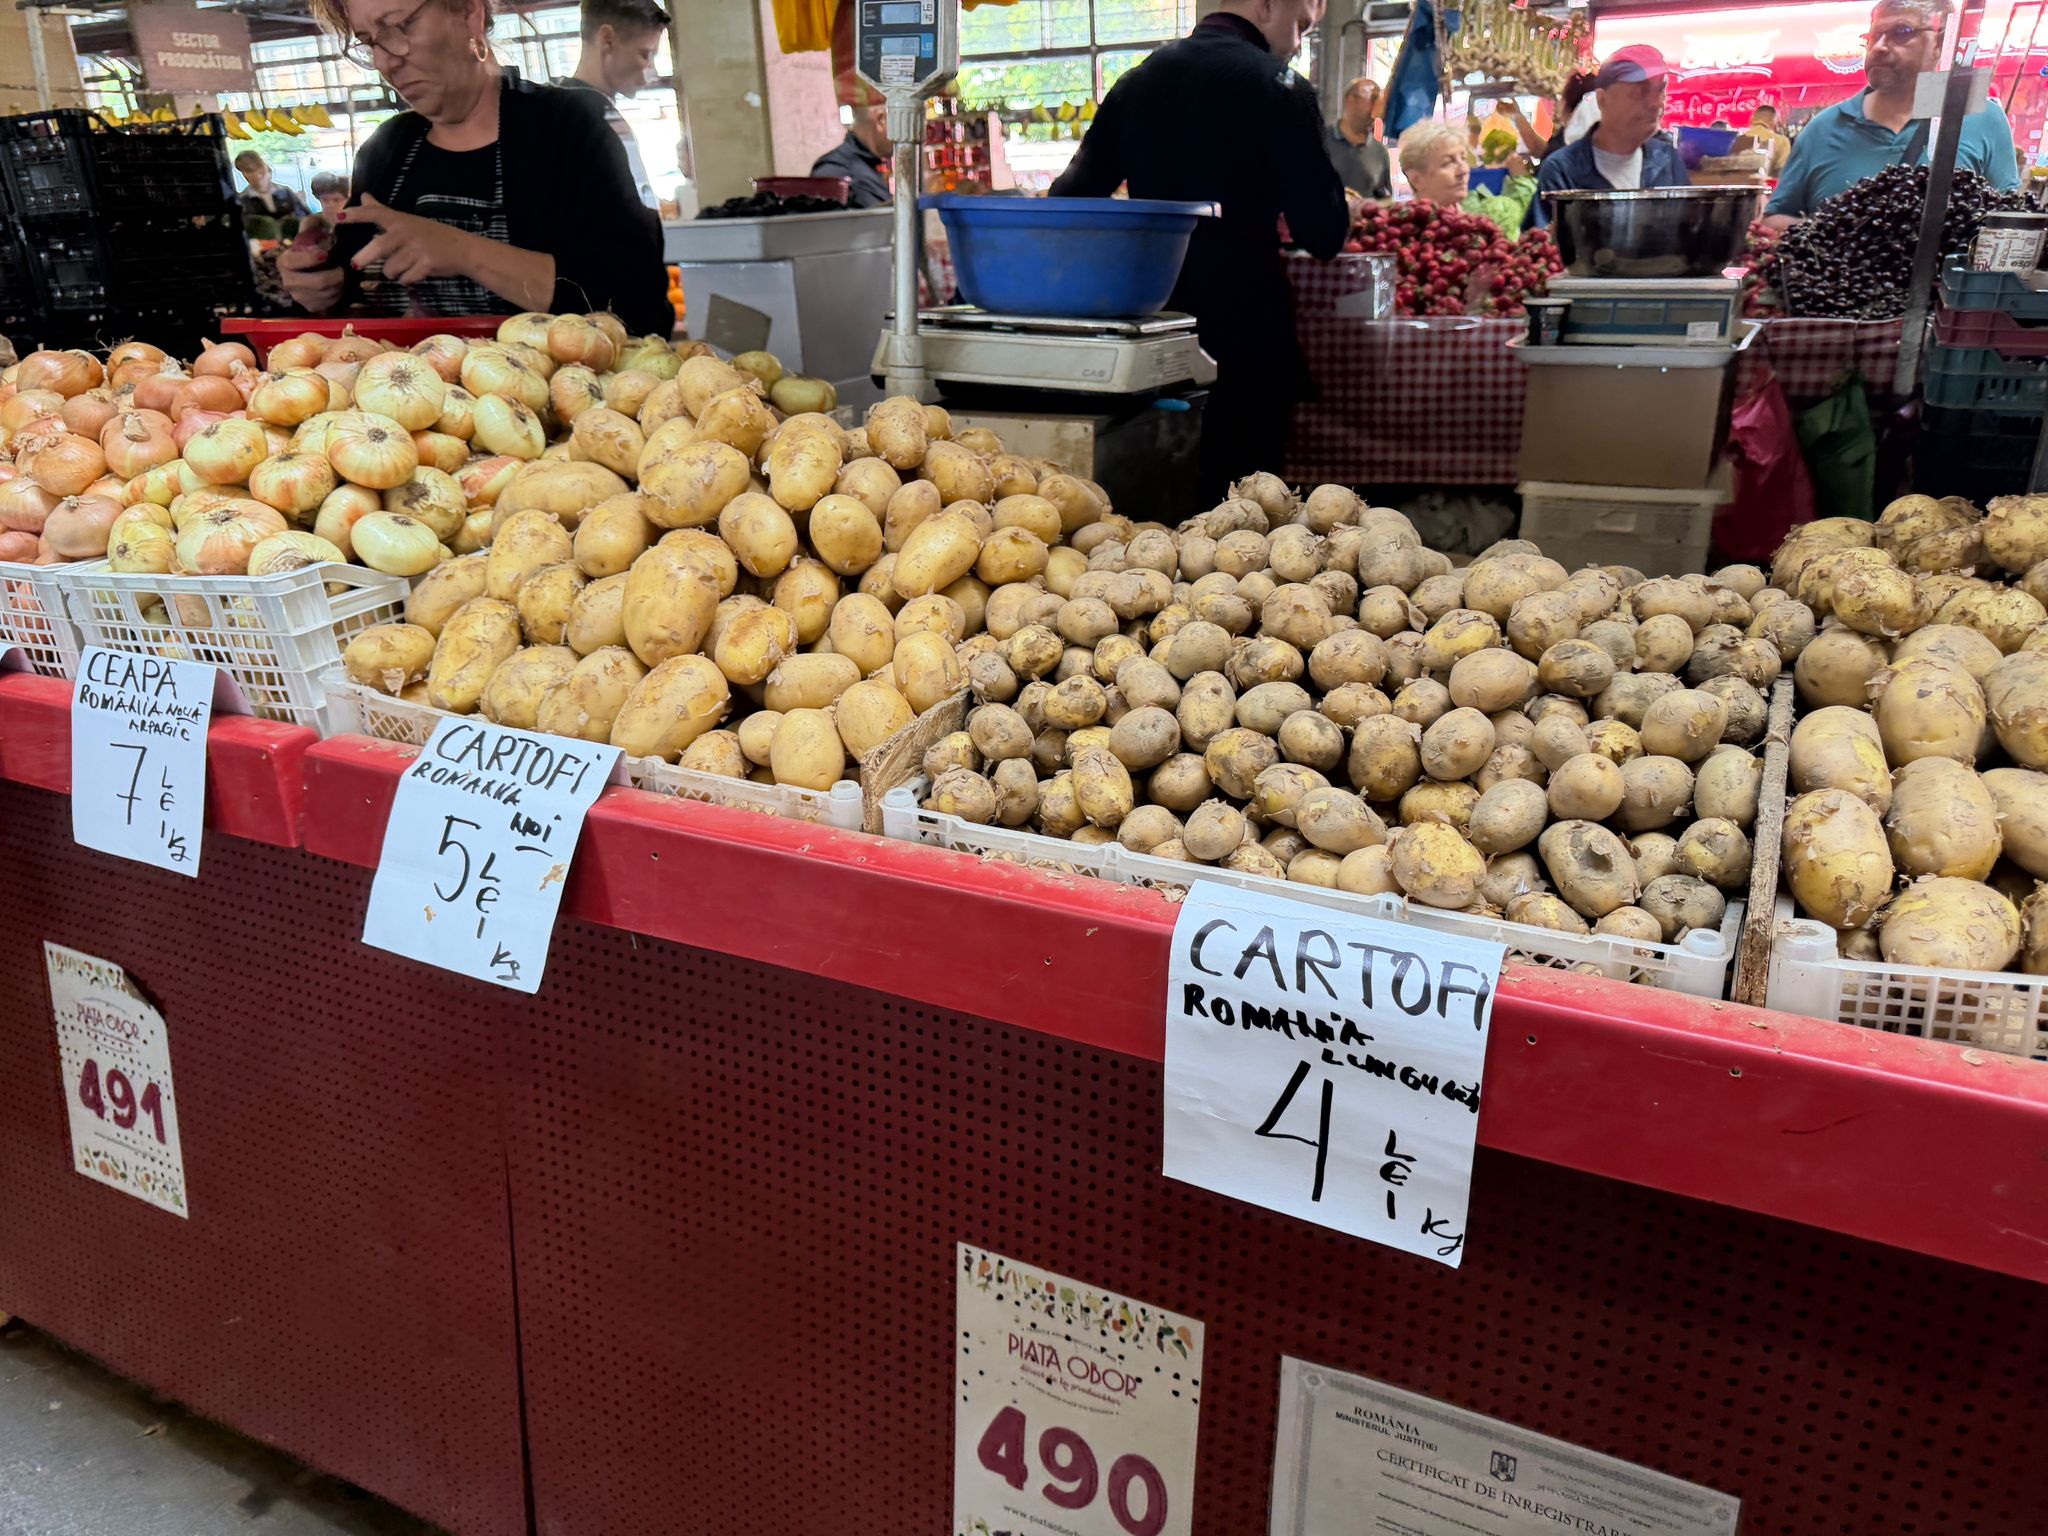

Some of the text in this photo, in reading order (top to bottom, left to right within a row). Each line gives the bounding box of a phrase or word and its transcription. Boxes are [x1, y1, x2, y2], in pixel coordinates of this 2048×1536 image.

[172, 32, 221, 48] SECTOR
[110, 742, 148, 825] 7
[433, 815, 482, 903] 5
[79, 1058, 166, 1145] 491
[1255, 1060, 1334, 1203] 4
[1067, 1356, 1137, 1399] OBOR
[1335, 1411, 1391, 1437] MINISTERUL
[977, 1405, 1168, 1536] 490
[1376, 1449, 1470, 1489] CERTIFICAT
[1475, 1481, 1497, 1500] DE
[1502, 1491, 1632, 1536] INREGISTRAR
